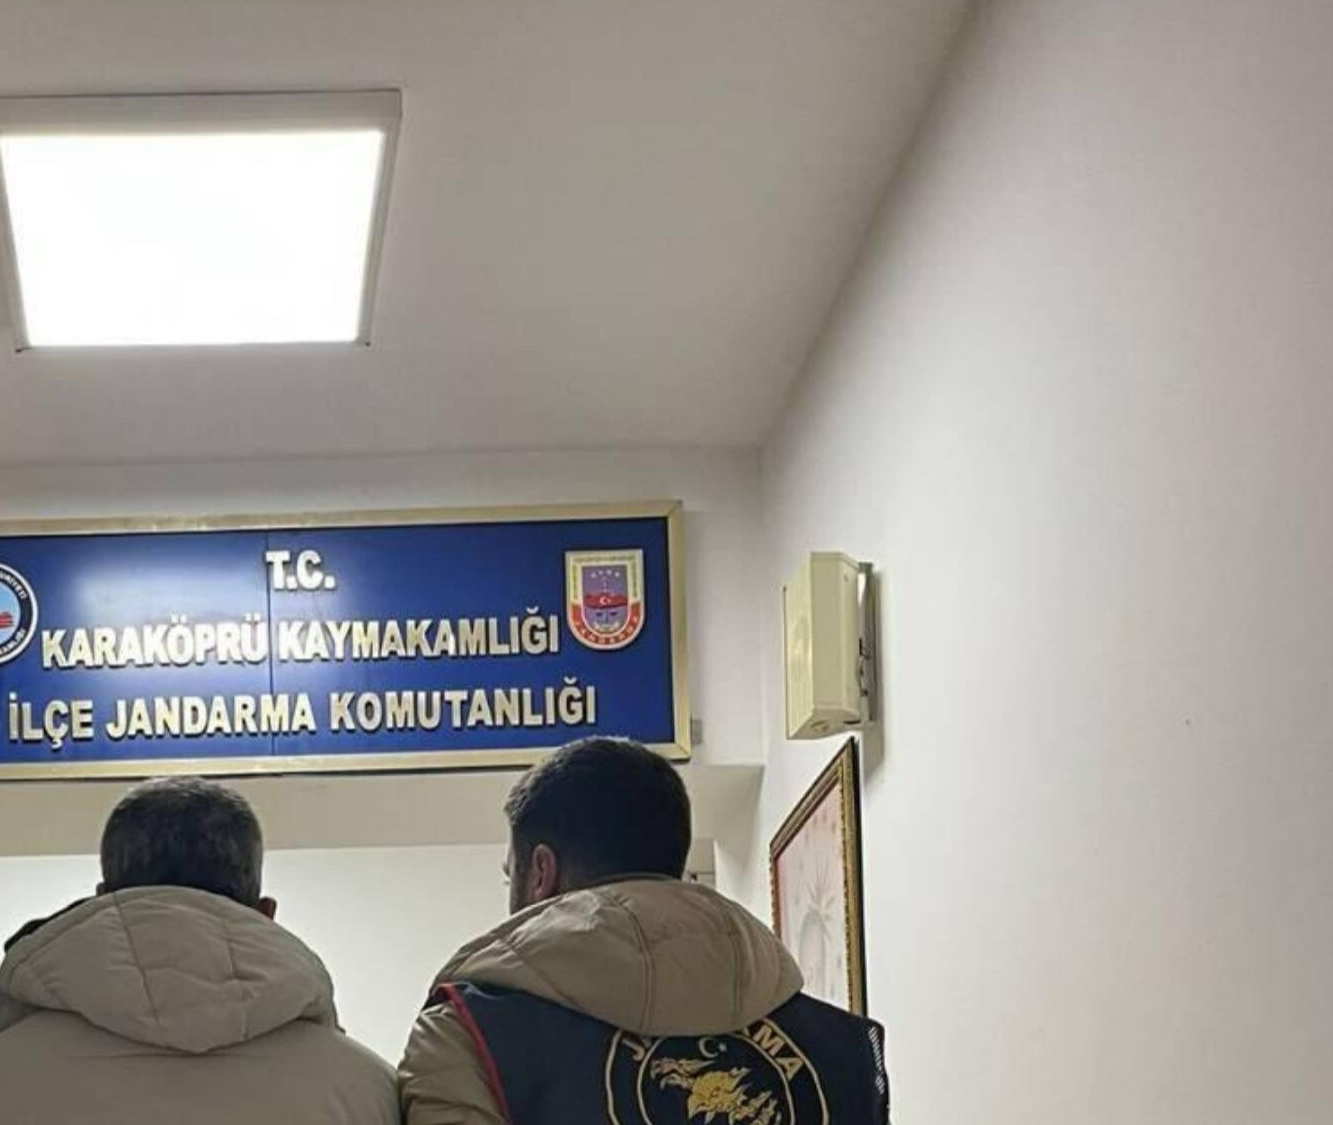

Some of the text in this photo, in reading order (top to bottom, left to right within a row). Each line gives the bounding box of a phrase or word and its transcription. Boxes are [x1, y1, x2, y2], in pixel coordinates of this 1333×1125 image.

[265, 549, 336, 590] T.C.
[41, 605, 560, 669] KARAKÖPRÜ KAYMAKAMLIĞI
[8, 676, 597, 750] İLÇE JANDARMA KOMUTANLIĞI
